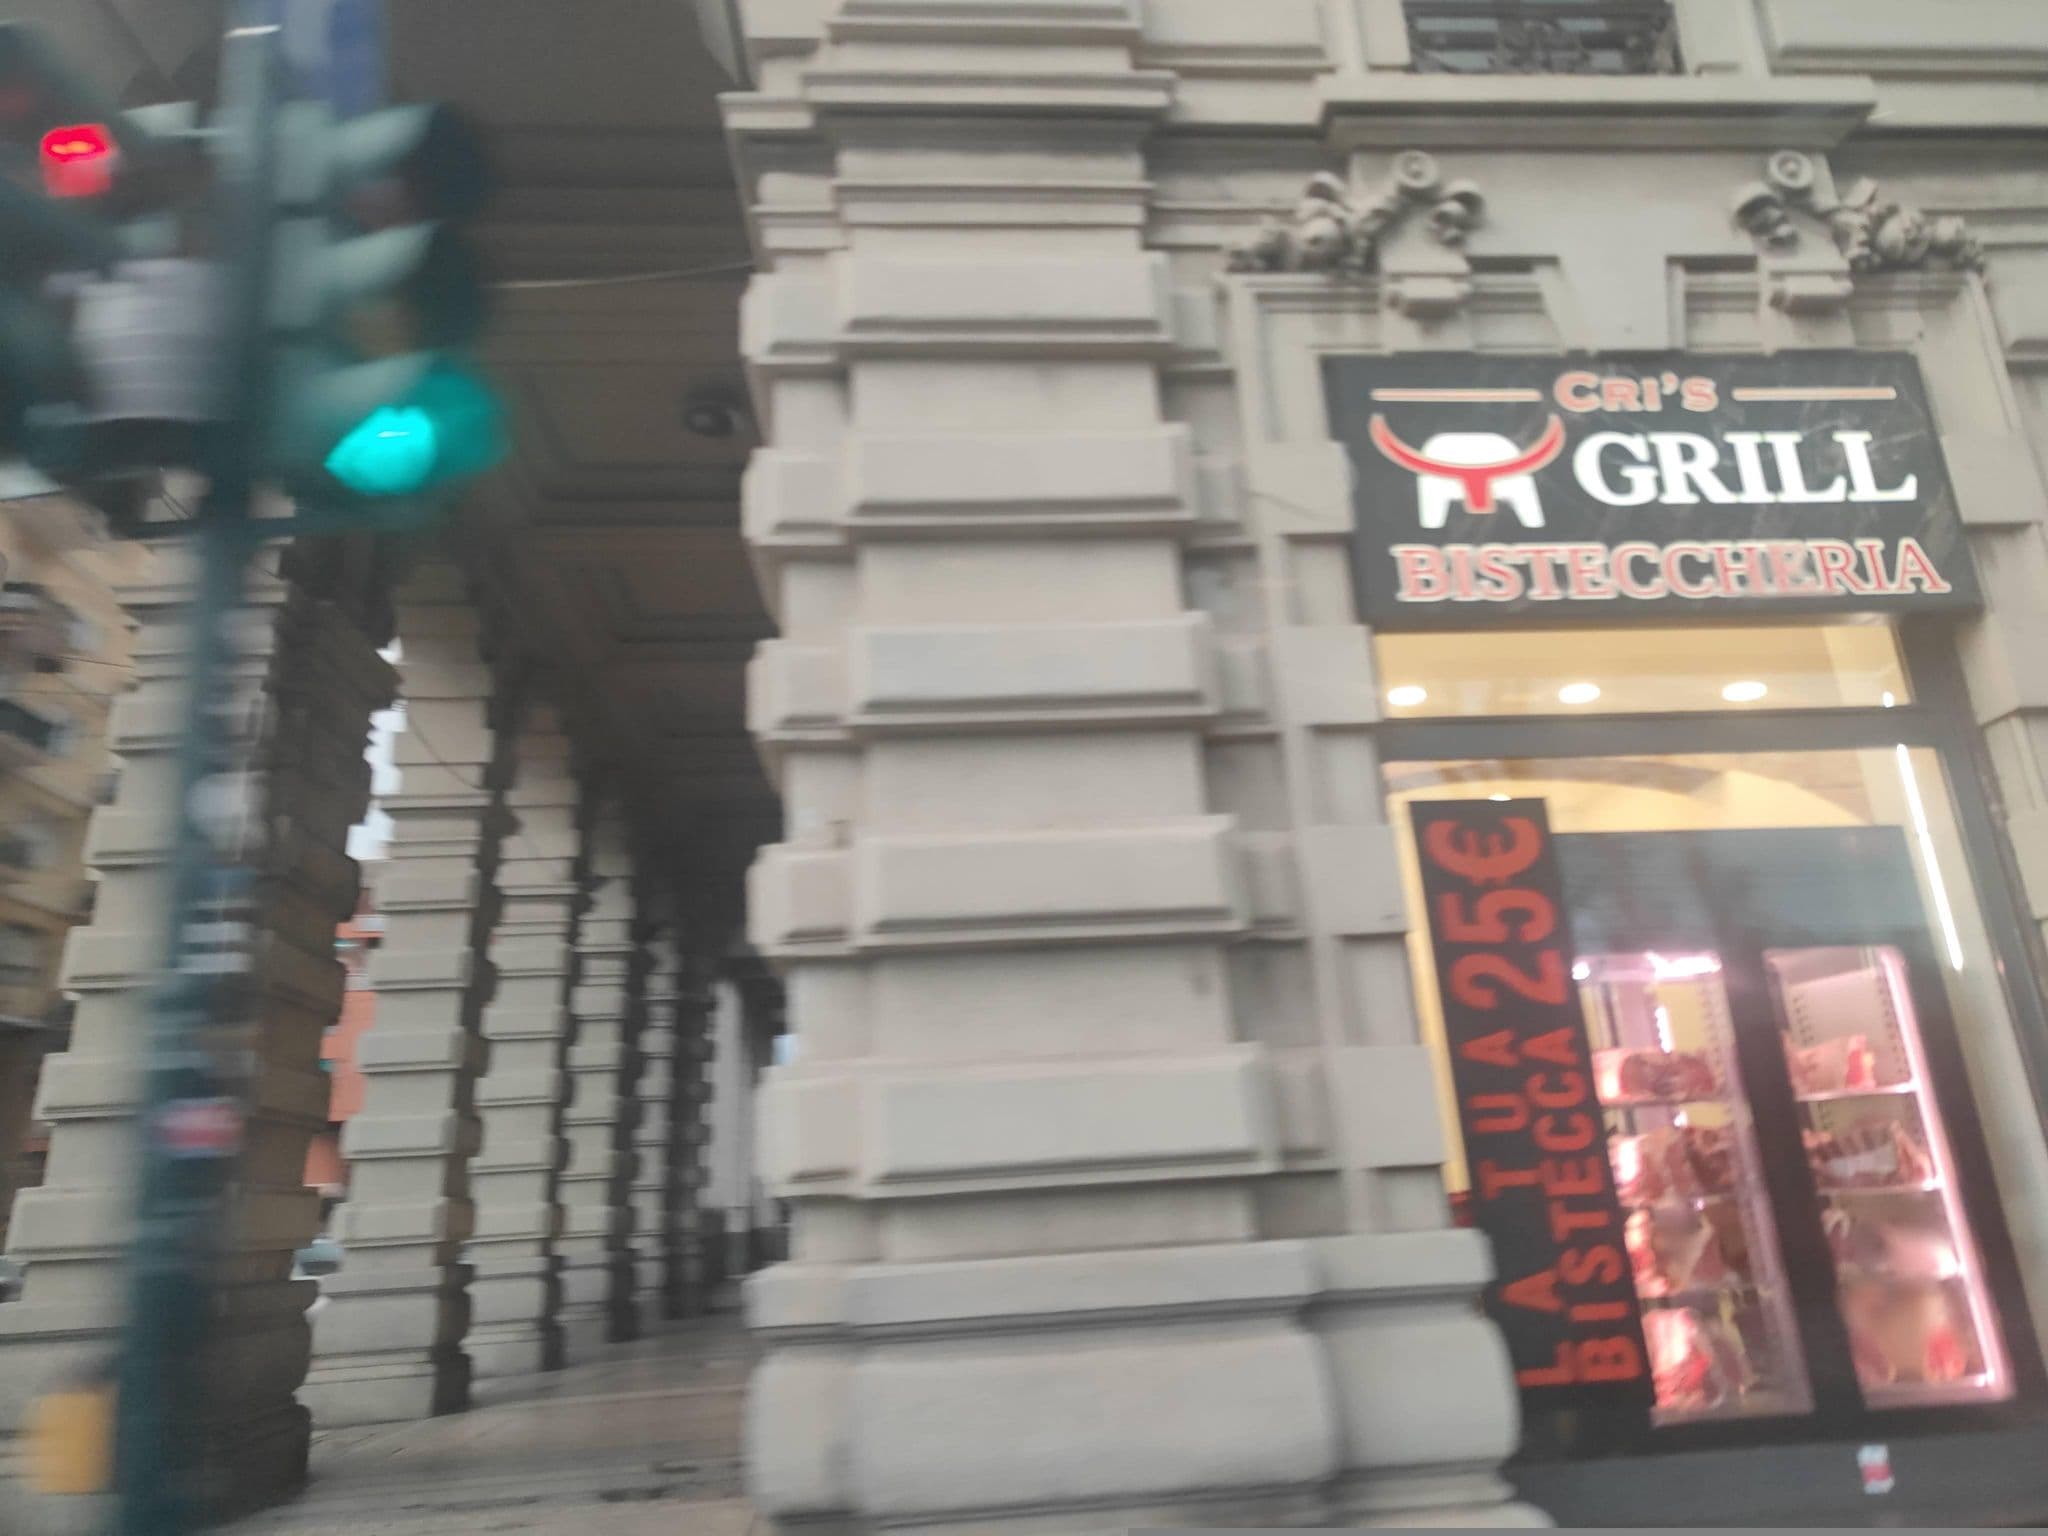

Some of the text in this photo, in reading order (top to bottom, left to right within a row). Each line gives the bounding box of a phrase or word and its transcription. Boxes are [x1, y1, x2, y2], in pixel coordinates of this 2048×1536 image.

[1572, 431, 1917, 506] GRILL
[1391, 538, 1951, 602] BISTECCHERIA
[1424, 816, 1568, 1008] 25€
[1460, 1028, 1576, 1387] LA TUA
[1522, 1027, 1642, 1382] BISTECCA
